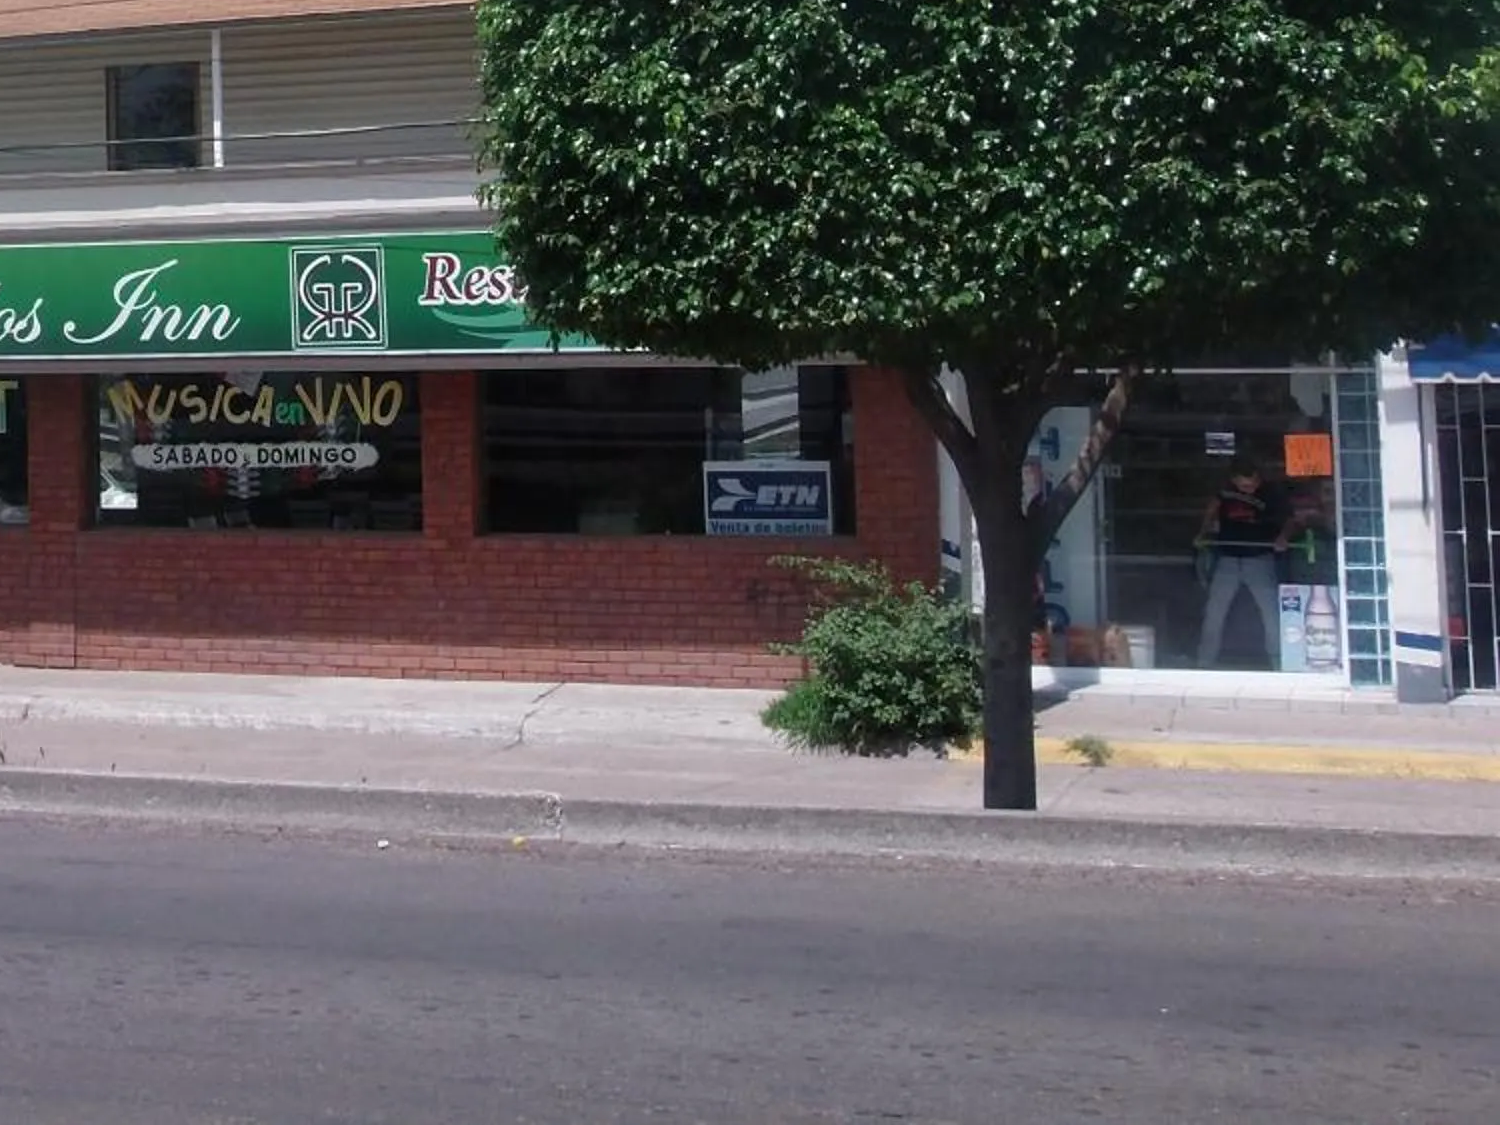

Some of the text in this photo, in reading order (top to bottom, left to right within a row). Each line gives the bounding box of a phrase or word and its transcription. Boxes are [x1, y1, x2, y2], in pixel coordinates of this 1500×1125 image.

[64, 259, 240, 344] Inn
[107, 376, 403, 427] MUSICA en VIVO
[152, 446, 238, 465] SABADO
[257, 447, 358, 465] DOMINGO
[754, 522, 771, 533] de
